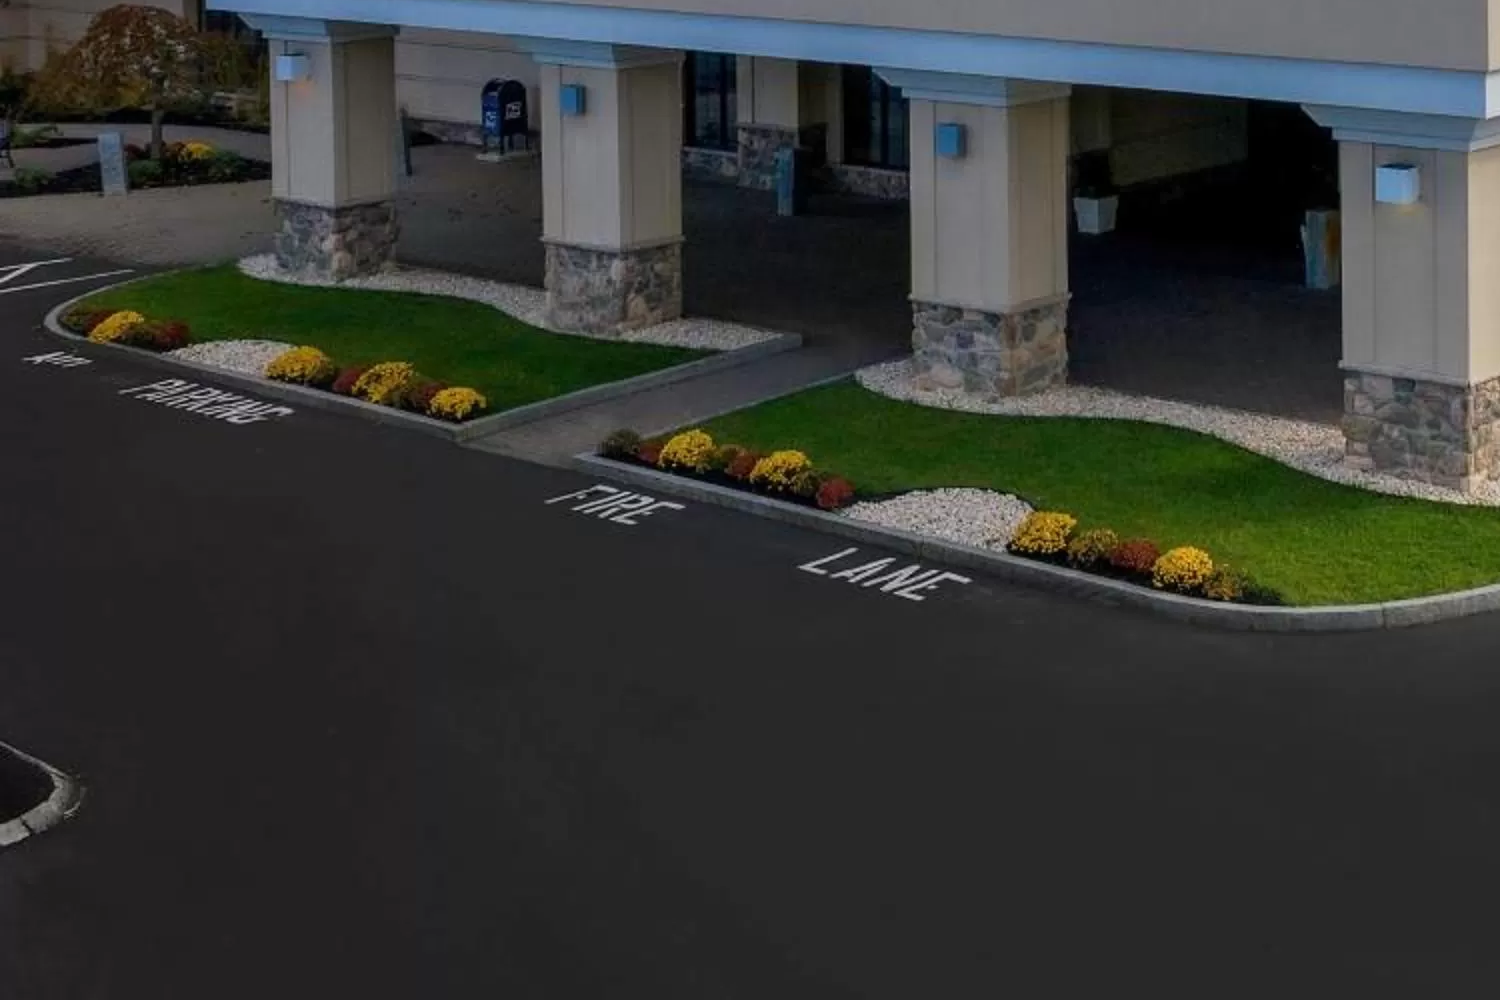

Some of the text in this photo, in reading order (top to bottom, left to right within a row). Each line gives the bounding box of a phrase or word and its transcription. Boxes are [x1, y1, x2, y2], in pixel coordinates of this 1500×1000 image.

[118, 378, 295, 424] PARKING
[543, 485, 686, 525] FIRE
[797, 547, 972, 601] LANE
